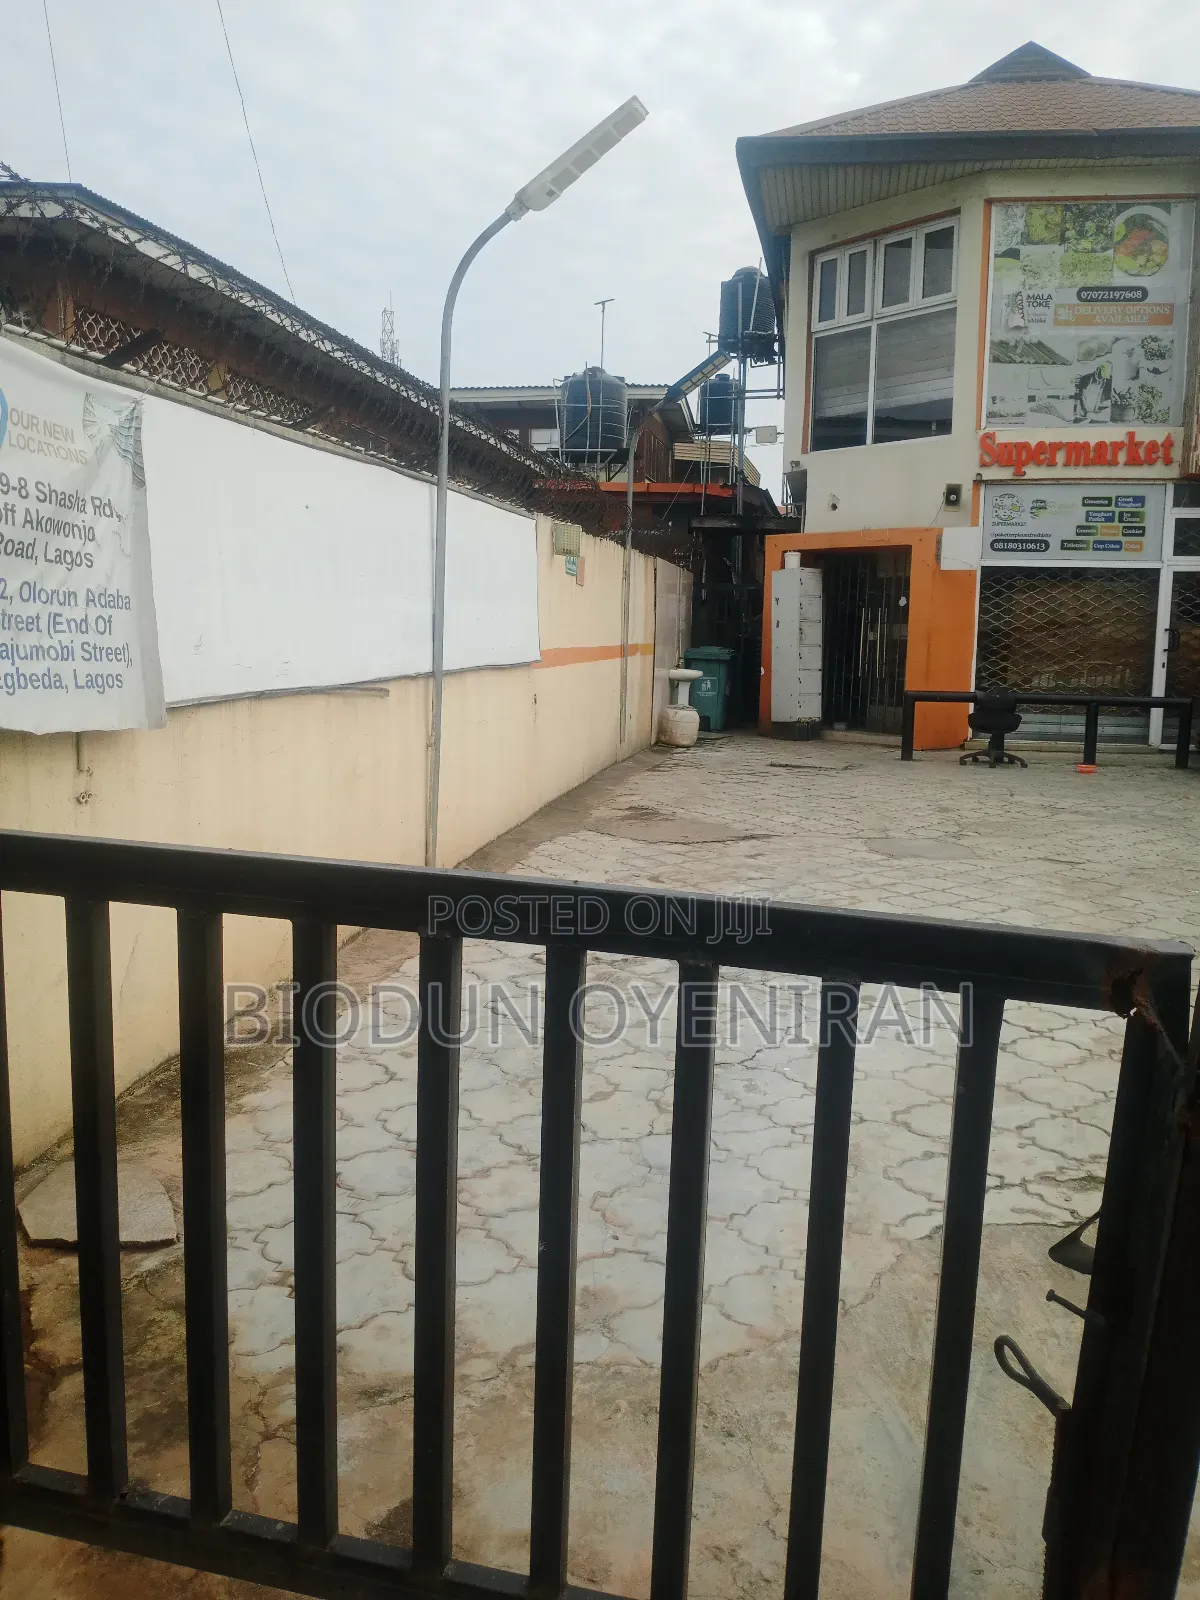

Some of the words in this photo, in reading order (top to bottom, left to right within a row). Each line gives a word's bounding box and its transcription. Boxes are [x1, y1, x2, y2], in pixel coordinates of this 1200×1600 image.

[1026, 293, 1053, 301] MALA
[1081, 291, 1142, 299] 07072197608
[1074, 306, 1124, 315] DELIVERY
[1125, 306, 1170, 314] OPTIONS
[1094, 314, 1149, 323] AVAILABLE
[9, 408, 40, 434] OUR
[43, 420, 75, 444] NEW
[8, 430, 88, 466] LOCATIONS
[979, 431, 1175, 477] Supermarket
[35, 480, 87, 515] Shasha
[22, 507, 96, 547] Akowonjo
[44, 541, 94, 572] Lagos
[993, 542, 1046, 551] 08180310613
[19, 580, 78, 607] Olorun
[86, 587, 131, 611] Adaba
[48, 611, 89, 640] (End
[95, 614, 113, 636] Of
[81, 641, 133, 668] Street),
[73, 668, 124, 695] Lagos
